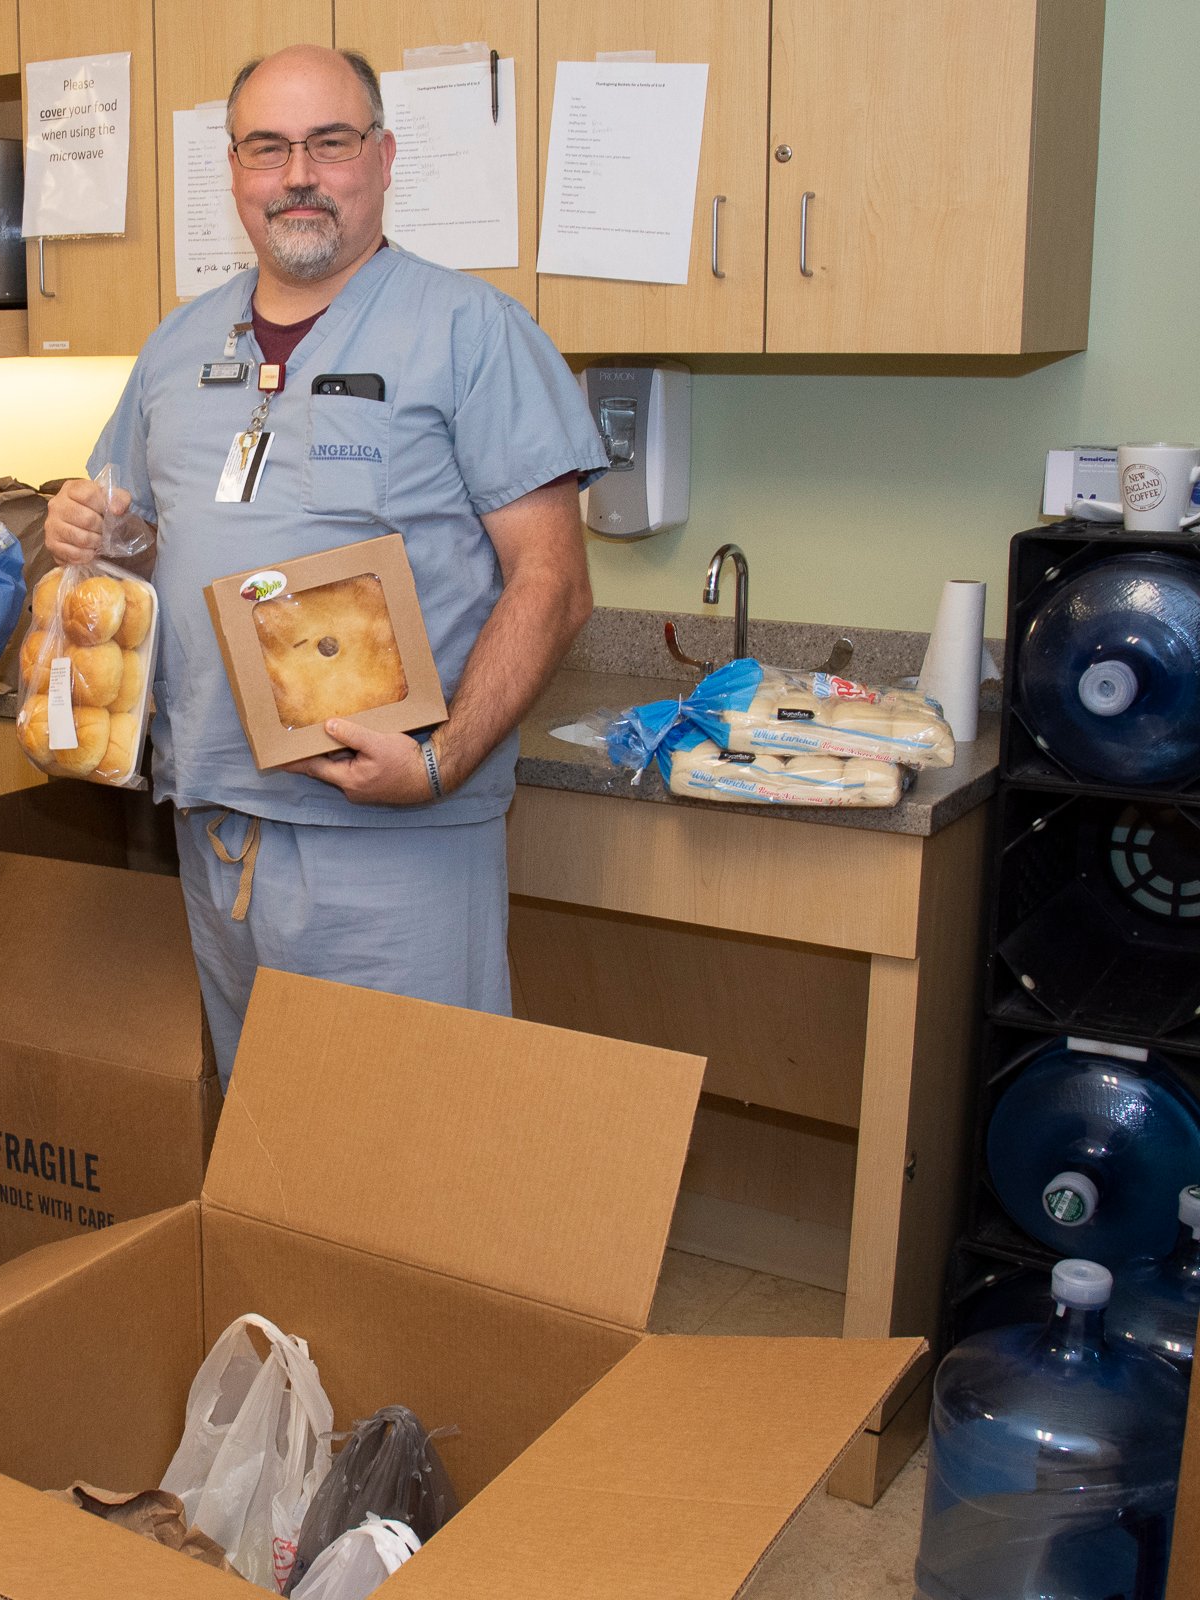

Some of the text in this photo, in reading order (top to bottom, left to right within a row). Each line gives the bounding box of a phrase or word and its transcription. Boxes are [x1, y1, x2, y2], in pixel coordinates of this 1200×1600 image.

[64, 79, 94, 92] Please
[40, 99, 118, 120] cover your food
[42, 124, 115, 141] when using the
[50, 149, 104, 162] microwave
[309, 445, 382, 458] ANGELICA
[1129, 472, 1145, 482] NEW
[1125, 479, 1159, 494] ENGLAND
[753, 729, 778, 741] White
[781, 733, 819, 747] Enriched
[692, 770, 714, 782] White
[718, 777, 756, 791] Enriched
[38, 1194, 72, 1223] WITH
